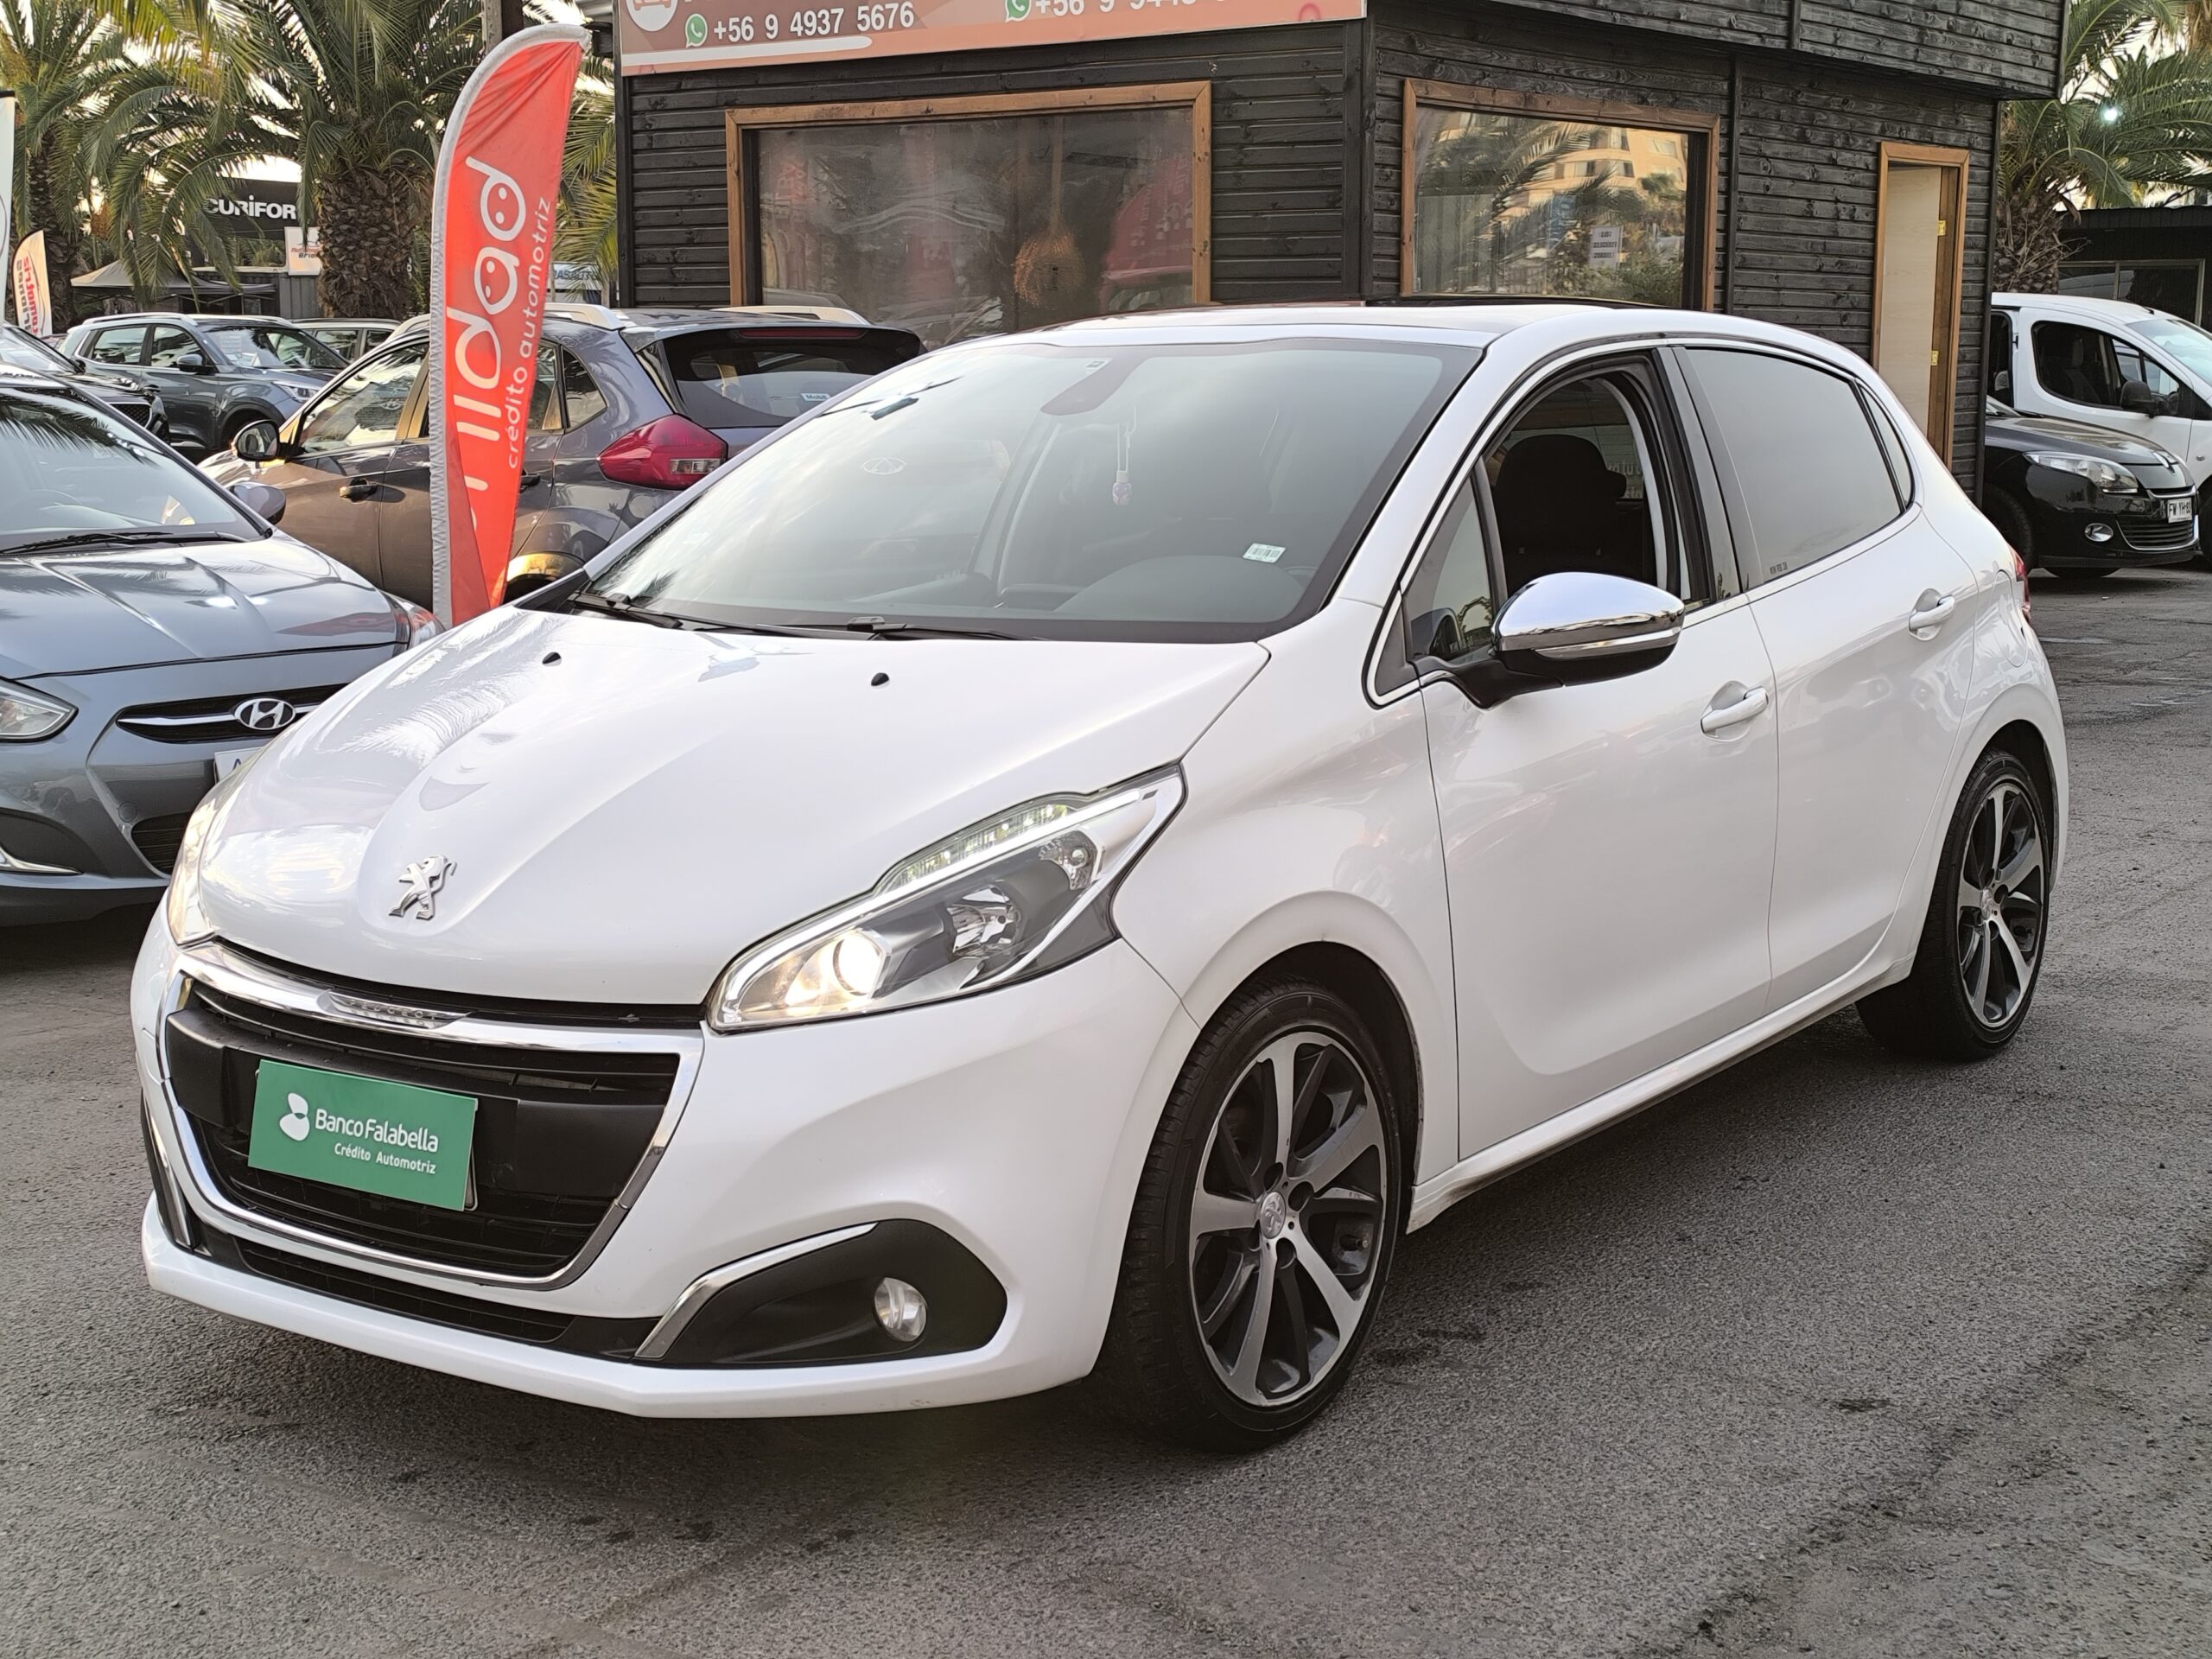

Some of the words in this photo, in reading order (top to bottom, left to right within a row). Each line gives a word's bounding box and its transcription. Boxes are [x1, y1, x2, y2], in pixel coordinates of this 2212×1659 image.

[714, 16, 754, 42] +56
[765, 14, 779, 40] 9
[790, 8, 844, 37] 4937
[856, 2, 914, 31] 5676
[504, 365, 528, 469] crédito
[520, 196, 552, 359] automotriz
[348, 999, 438, 1020] PEUGEOT
[334, 1142, 372, 1161] Crédito
[376, 1151, 437, 1174] Automotriz
